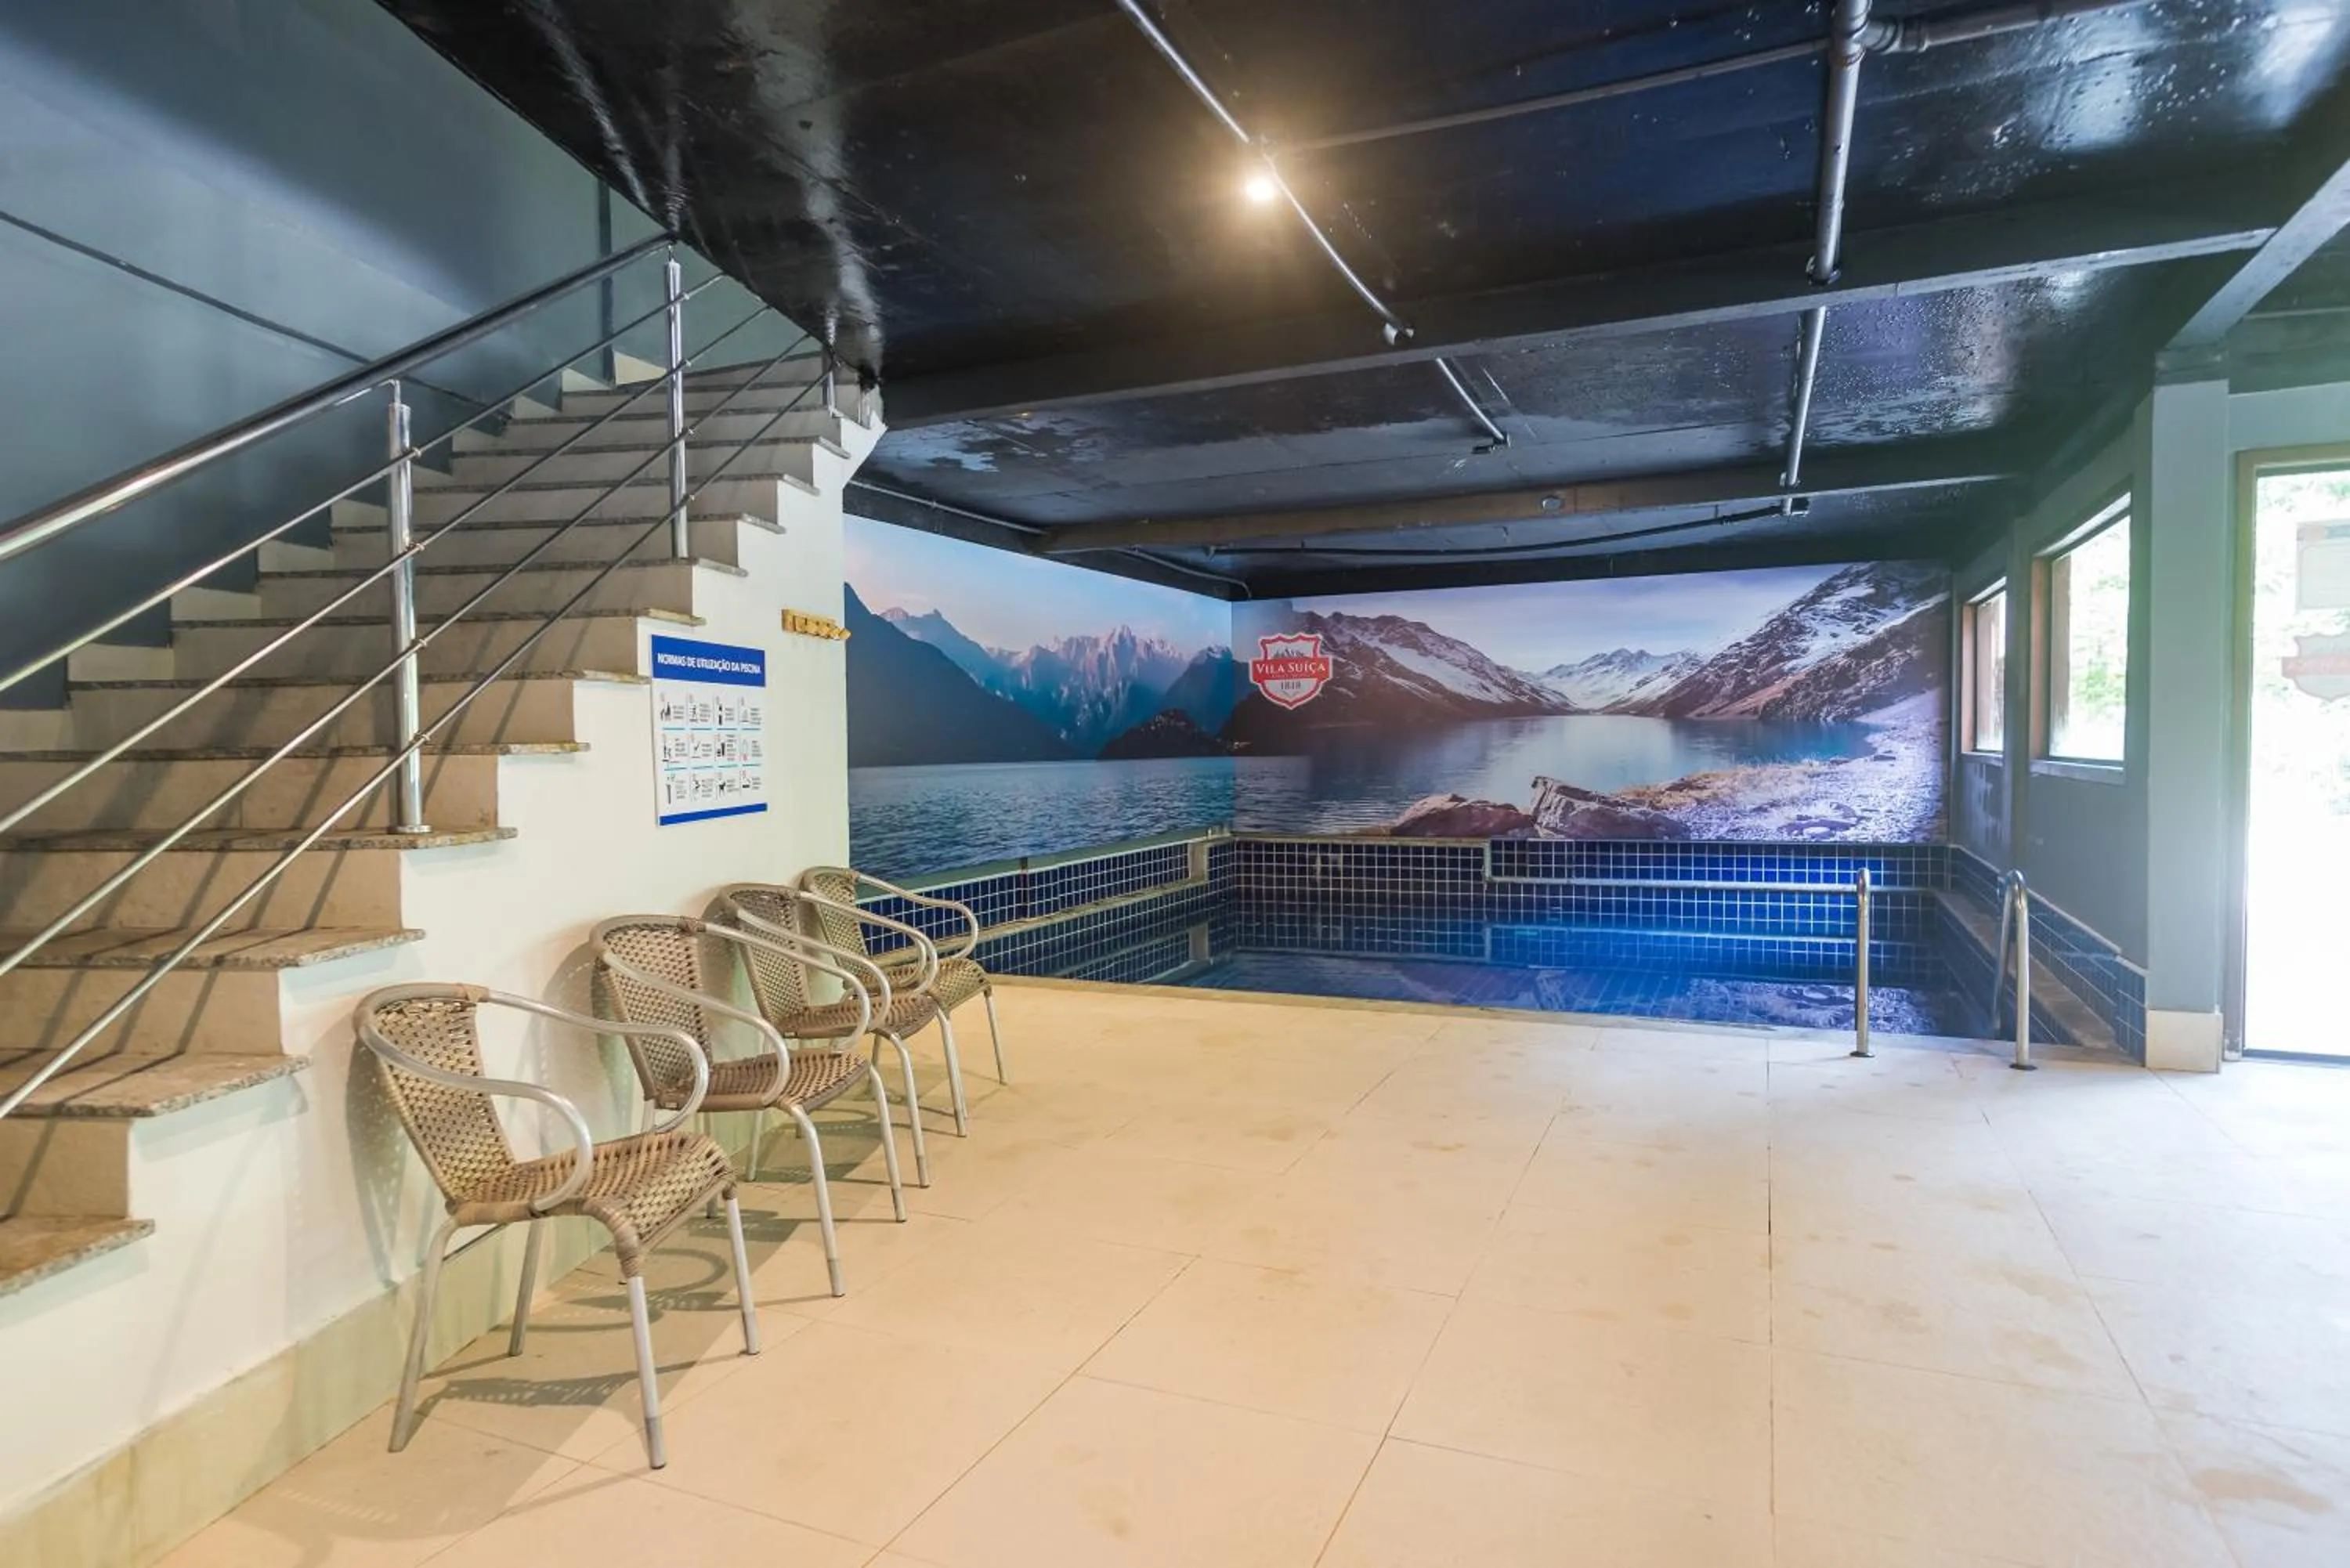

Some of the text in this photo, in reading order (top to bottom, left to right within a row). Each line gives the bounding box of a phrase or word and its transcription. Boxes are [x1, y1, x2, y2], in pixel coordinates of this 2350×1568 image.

[657, 652, 761, 674] NORMAS DE UTILIZAÇÃO DA PISCINA
[1256, 663, 1285, 674] VILA
